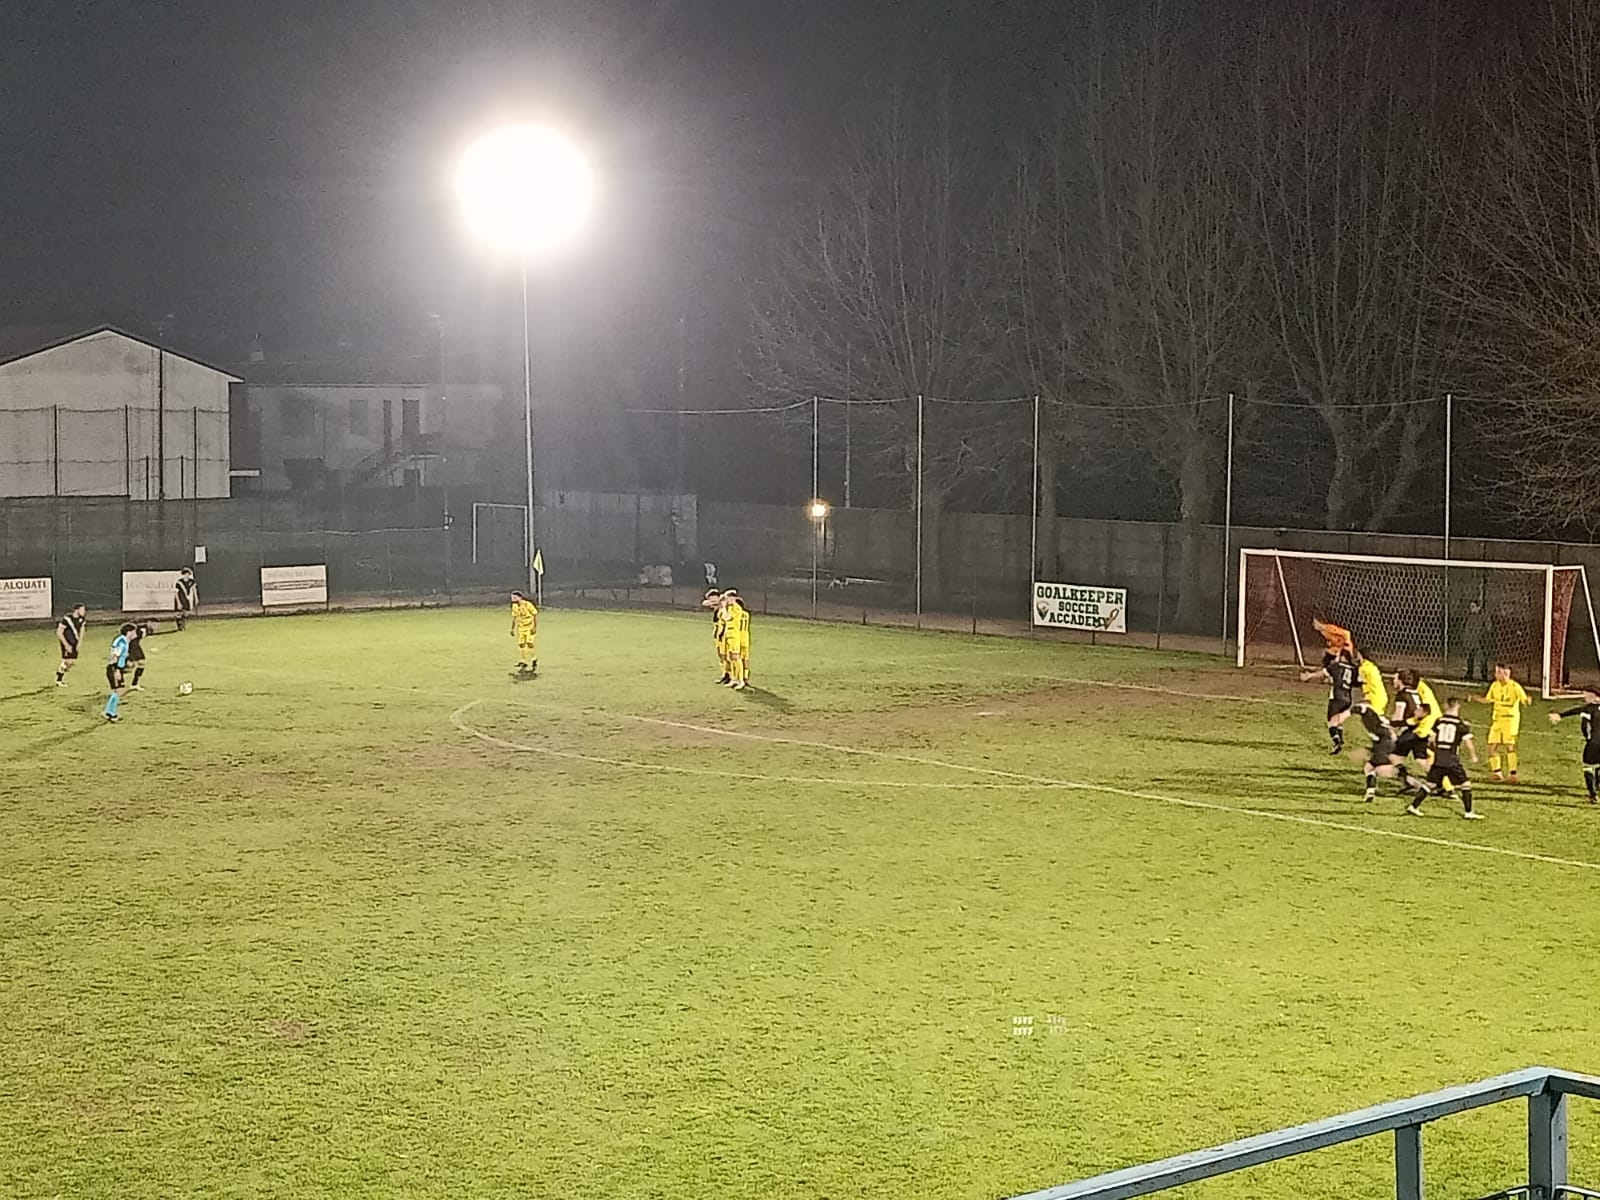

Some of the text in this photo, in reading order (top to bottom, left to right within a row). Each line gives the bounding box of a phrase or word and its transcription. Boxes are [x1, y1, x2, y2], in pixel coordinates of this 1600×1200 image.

[3, 580, 46, 591] ALOUATI
[1036, 586, 1123, 604] GOALKEEPER
[1058, 601, 1099, 615] SOCCER
[1436, 723, 1457, 743] 10
